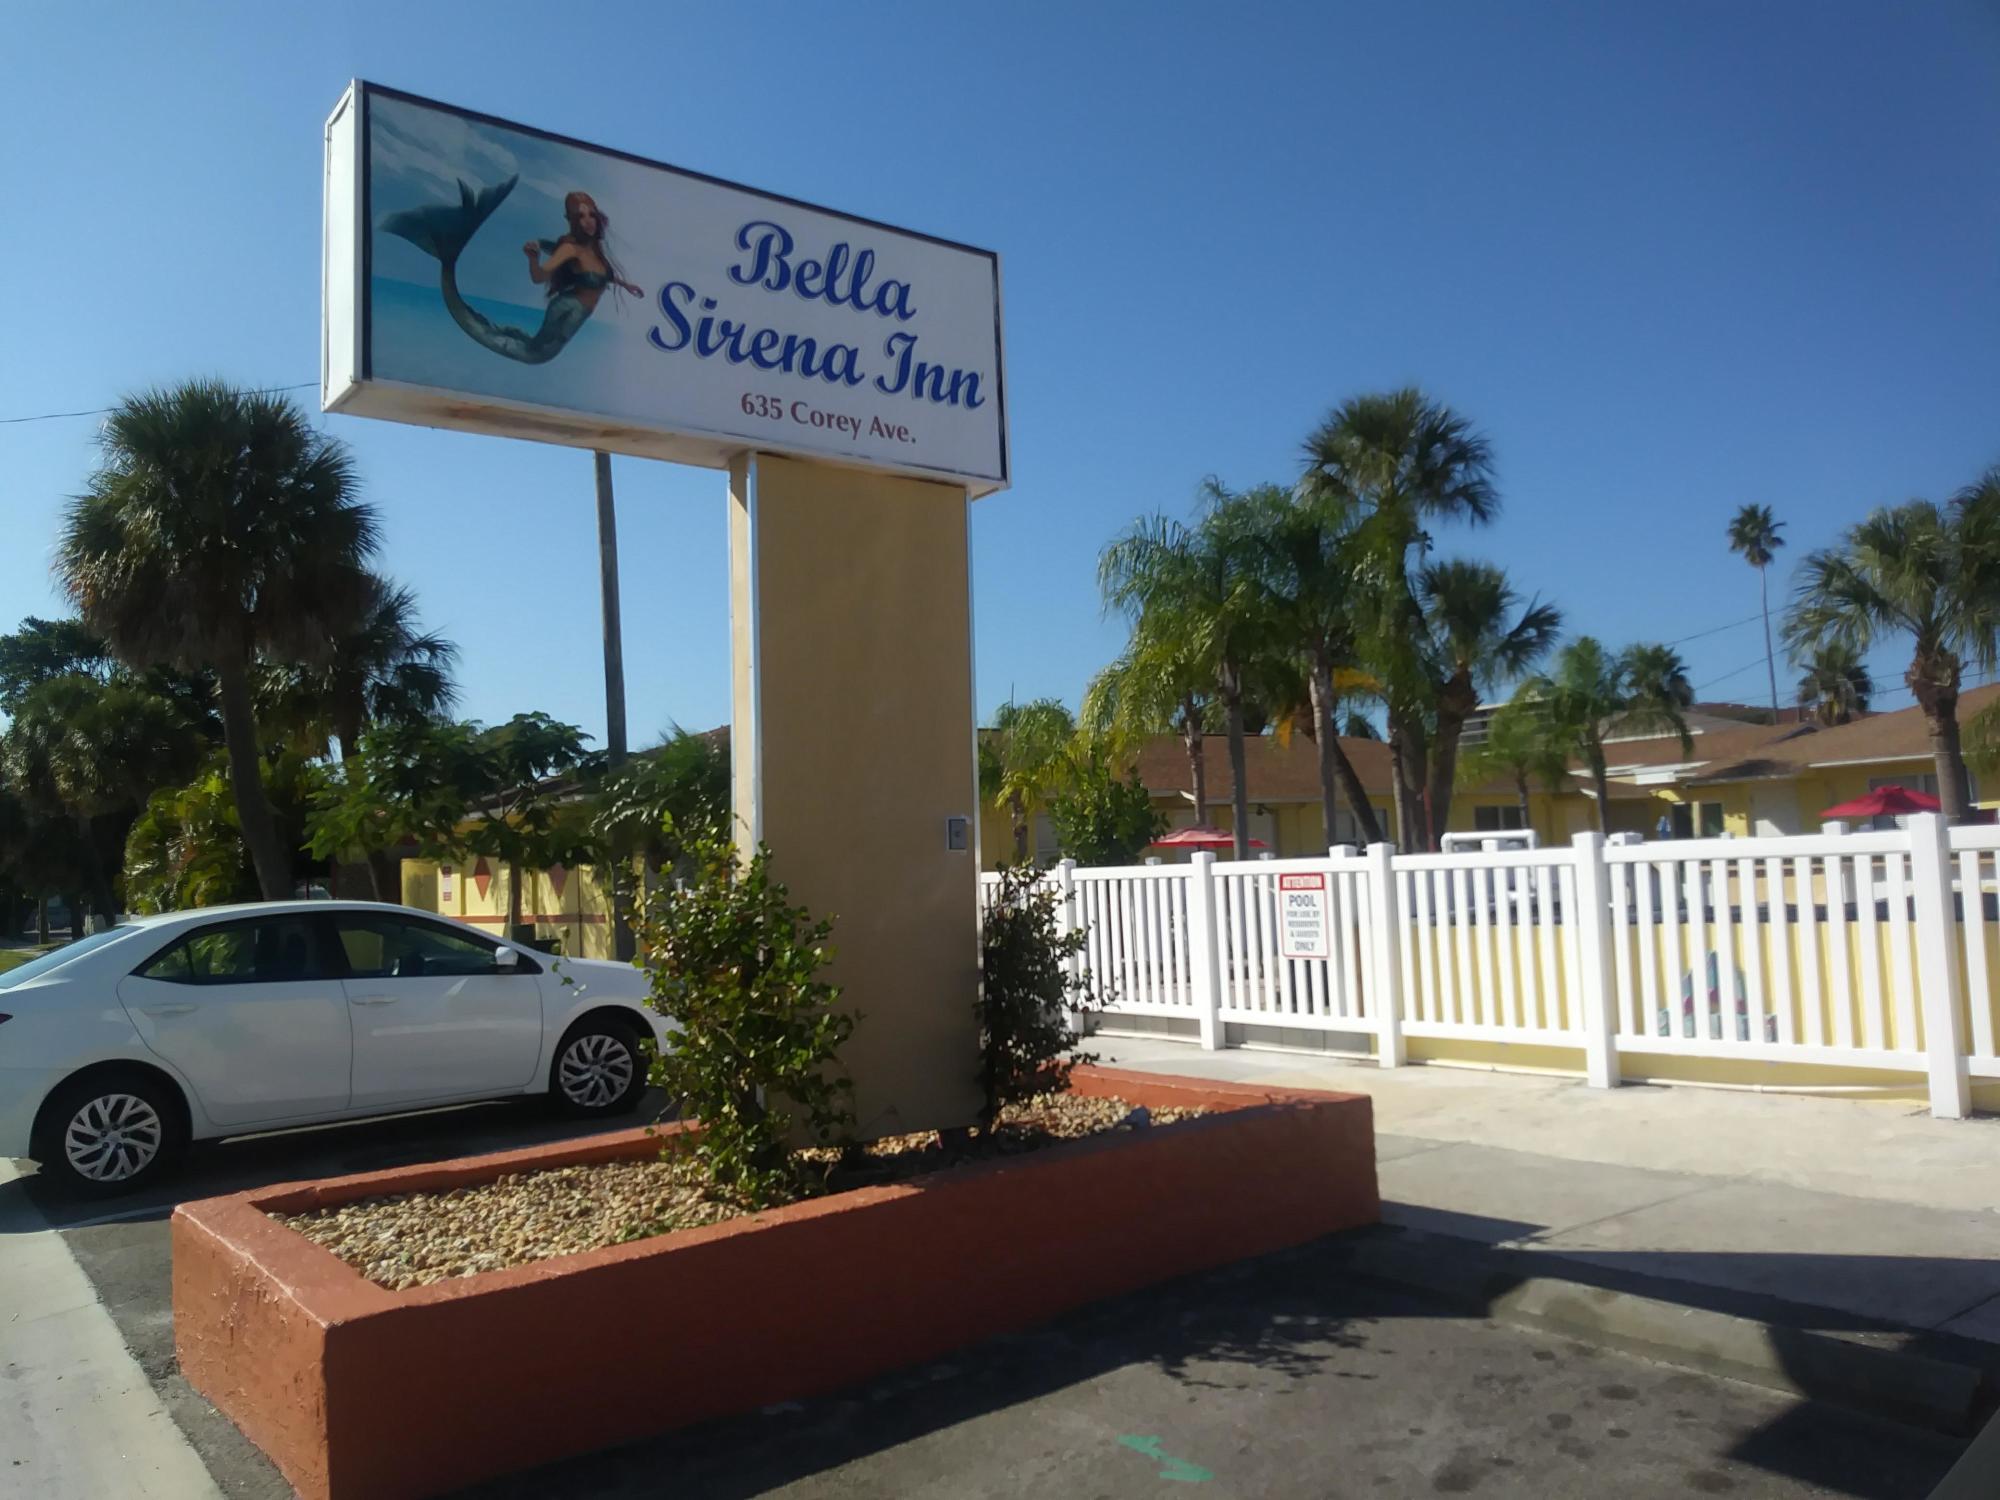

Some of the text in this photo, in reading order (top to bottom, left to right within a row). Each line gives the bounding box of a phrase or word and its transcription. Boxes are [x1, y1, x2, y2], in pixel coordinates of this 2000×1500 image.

[728, 220, 917, 321] Bella
[648, 281, 986, 409] Sirena Inn
[740, 392, 917, 444] 635 Corey Ave.
[1288, 894, 1317, 907] POOL
[1294, 941, 1315, 952] ONLY
